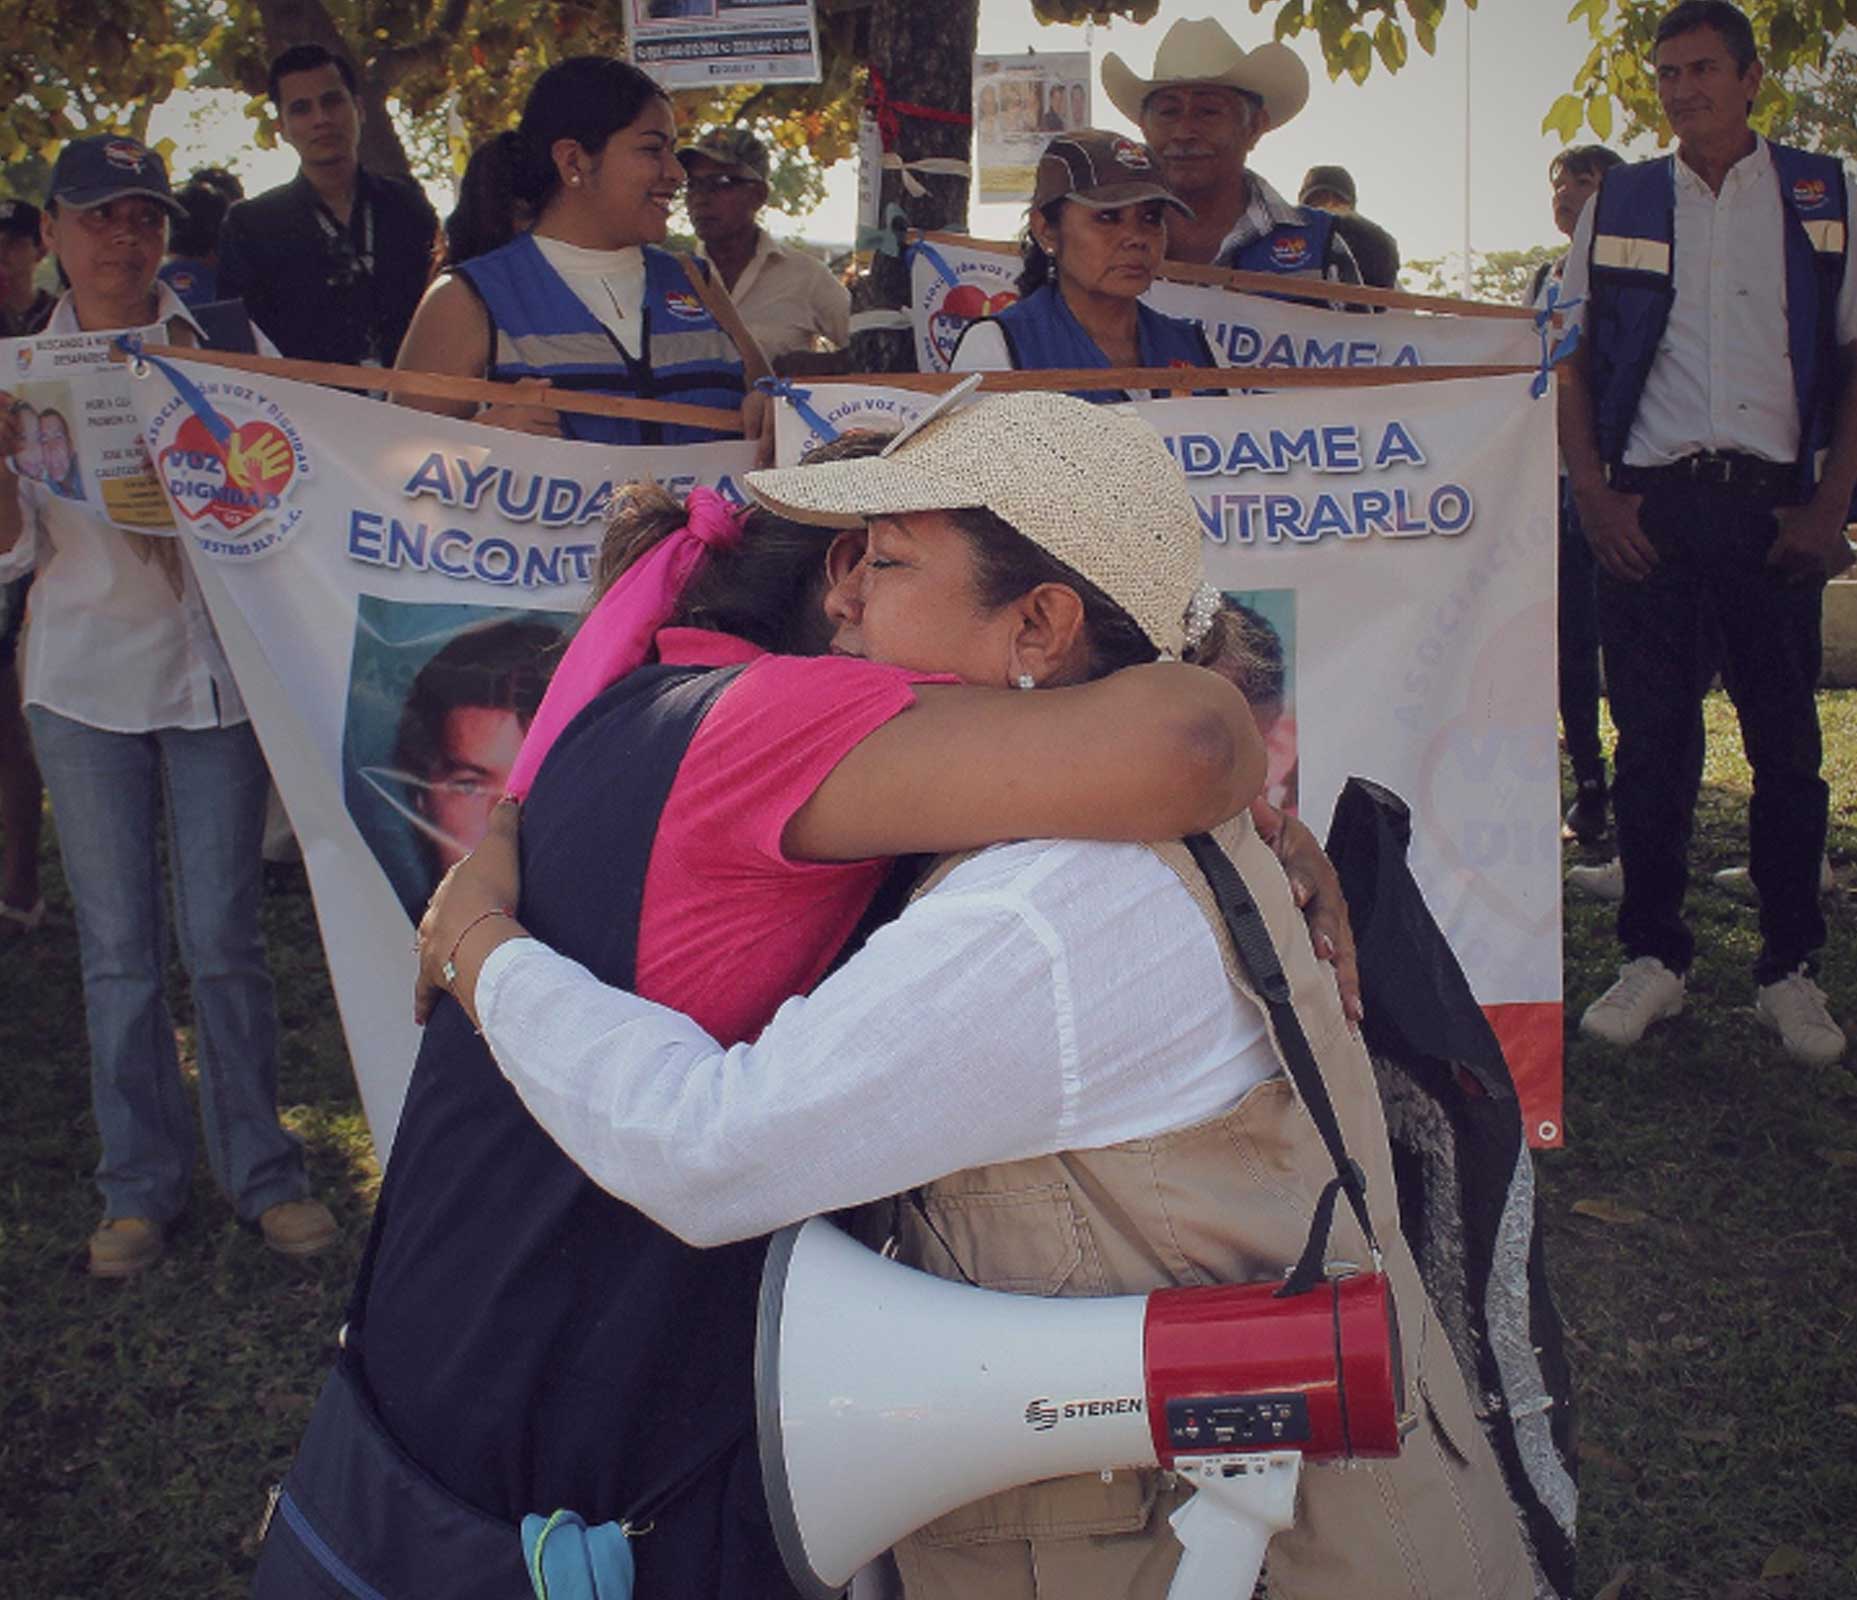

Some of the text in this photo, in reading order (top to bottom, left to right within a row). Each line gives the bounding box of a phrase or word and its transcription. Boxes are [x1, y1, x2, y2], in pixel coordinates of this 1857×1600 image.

[1216, 323, 1376, 367] DAME
[149, 382, 219, 446] ASOCIAÓN
[222, 384, 255, 400] VOZ
[266, 403, 310, 473] DIGNIDAD
[865, 398, 895, 411] VOZ
[169, 450, 222, 475] VOZ
[1163, 421, 1422, 472] DAME A
[169, 479, 281, 510] DIGNIDAD
[404, 452, 696, 523] AYUDAE
[1192, 484, 1470, 540] NTRARLO
[197, 537, 252, 556] ESTROS
[348, 509, 598, 586] ENCONT
[1452, 727, 1560, 783] VO
[1063, 1398, 1142, 1419] STEREN
